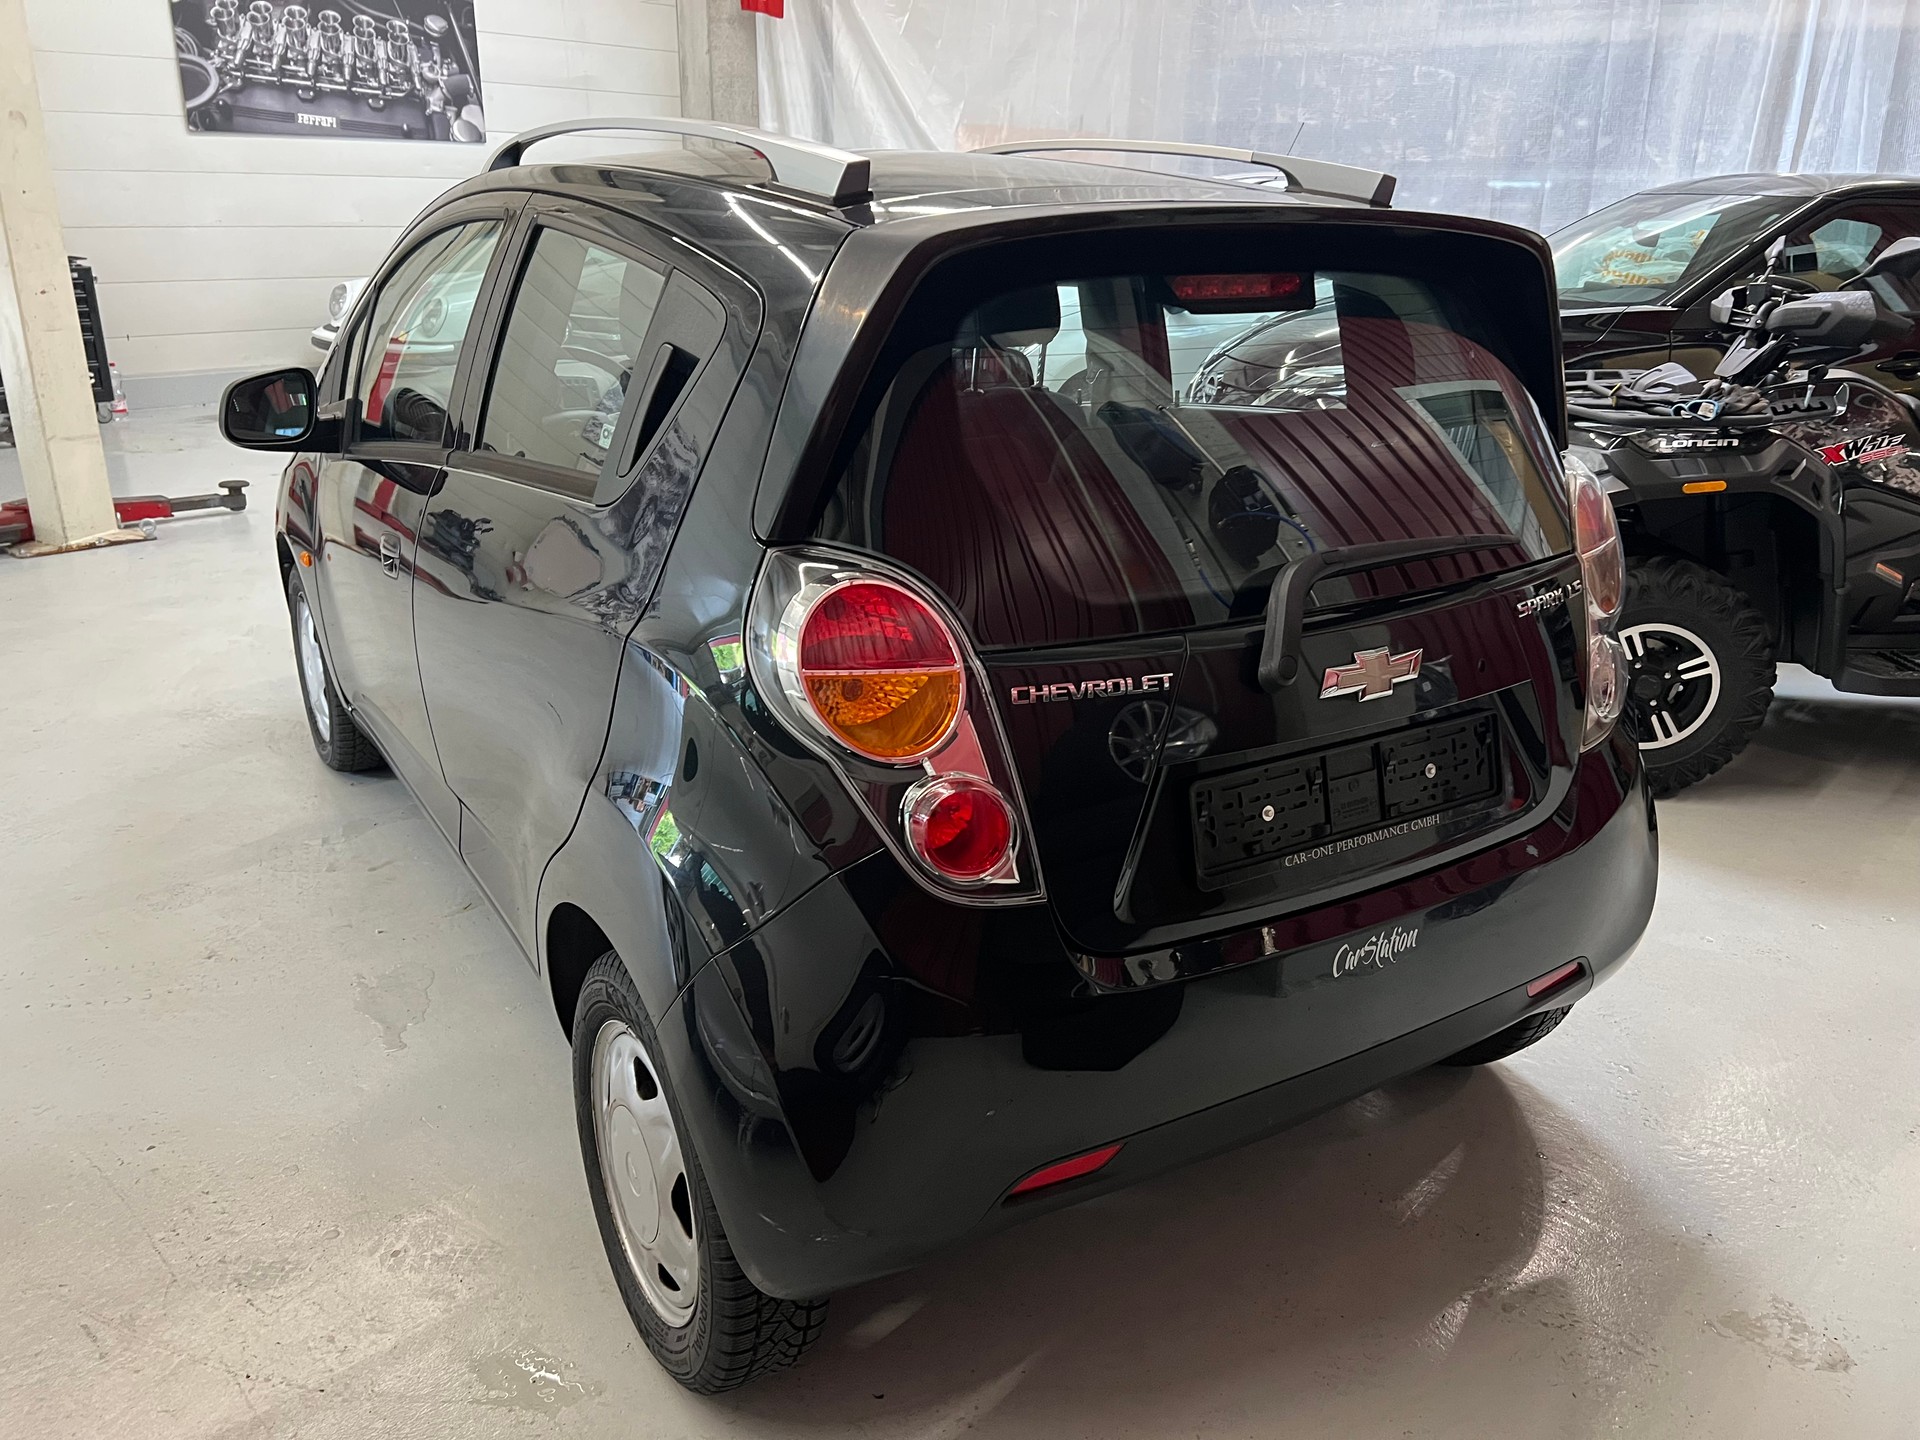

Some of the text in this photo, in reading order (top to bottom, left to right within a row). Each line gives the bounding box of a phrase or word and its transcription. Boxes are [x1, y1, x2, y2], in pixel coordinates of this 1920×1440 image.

[297, 112, 337, 128] Ferrari
[1516, 591, 1564, 618] SPARK
[1011, 672, 1174, 705] CHEVROLET
[1284, 813, 1441, 868] CAR-ONE PERFORMANCE GMBH
